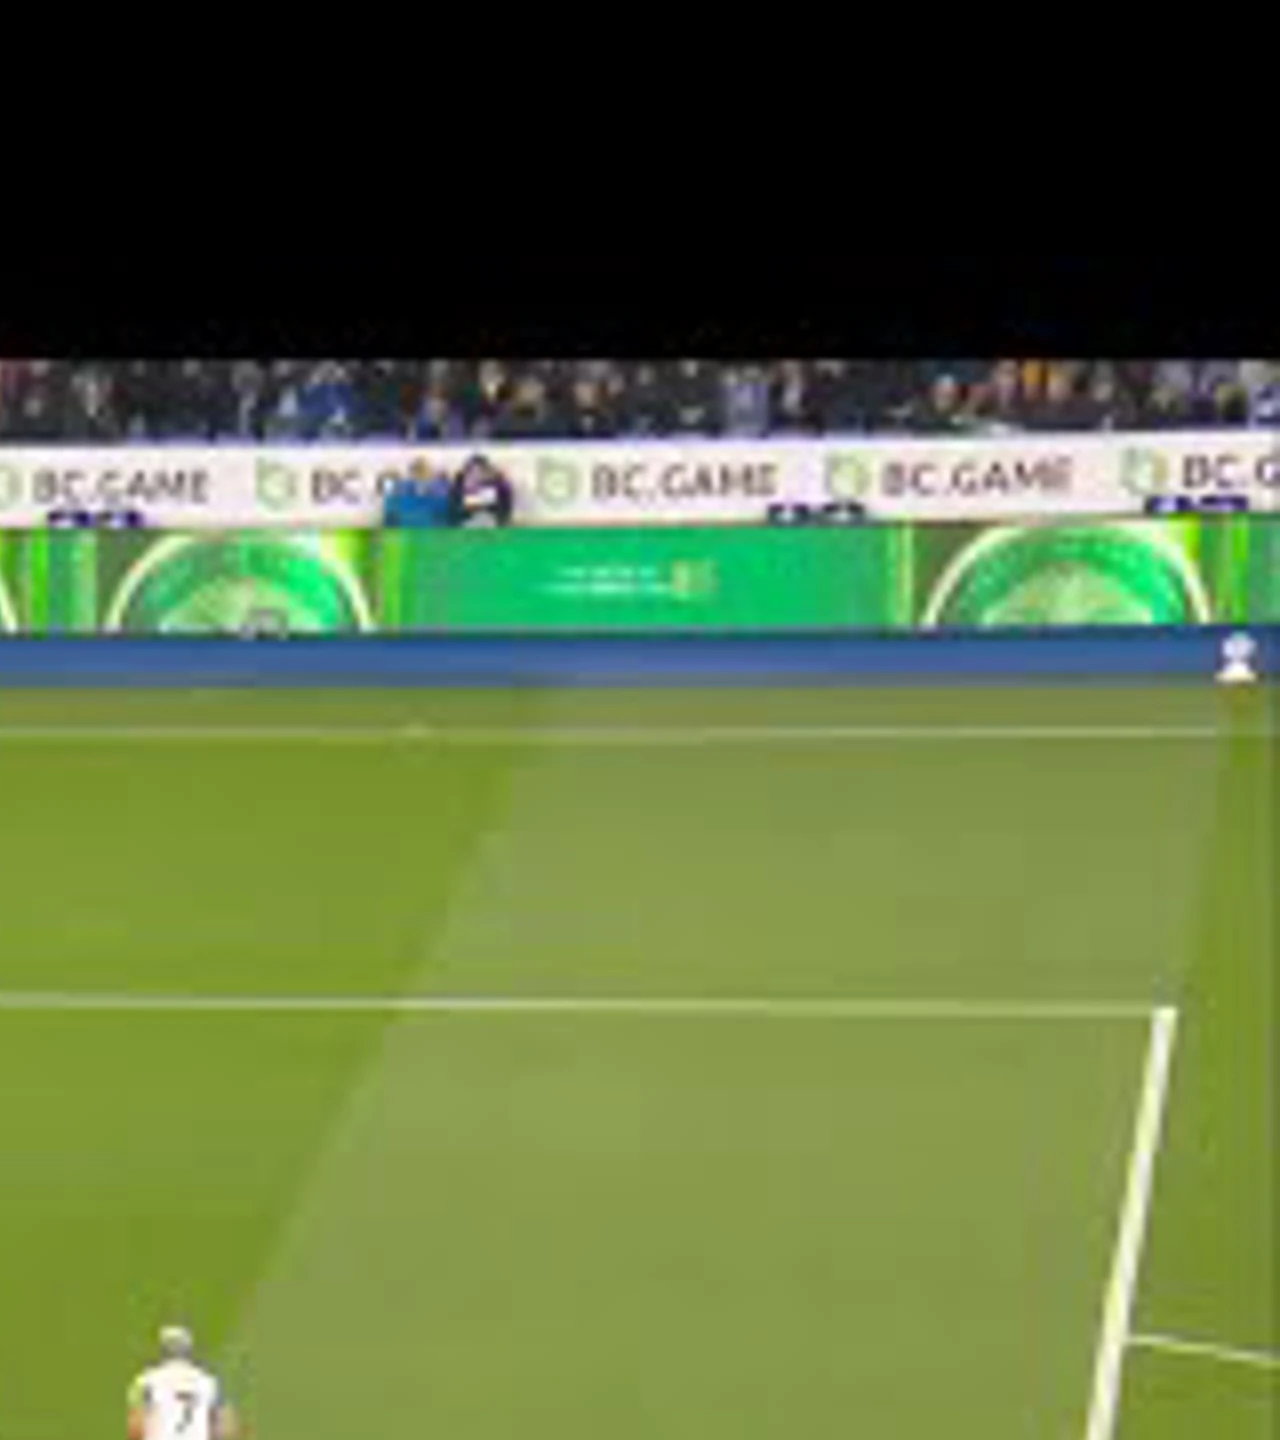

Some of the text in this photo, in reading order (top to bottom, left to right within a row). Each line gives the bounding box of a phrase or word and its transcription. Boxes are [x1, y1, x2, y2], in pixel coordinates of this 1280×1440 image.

[32, 467, 208, 504] BC.GAME
[591, 461, 777, 500] BC.GAME
[882, 454, 1072, 493] BC.GAME
[174, 1390, 196, 1434] 7
